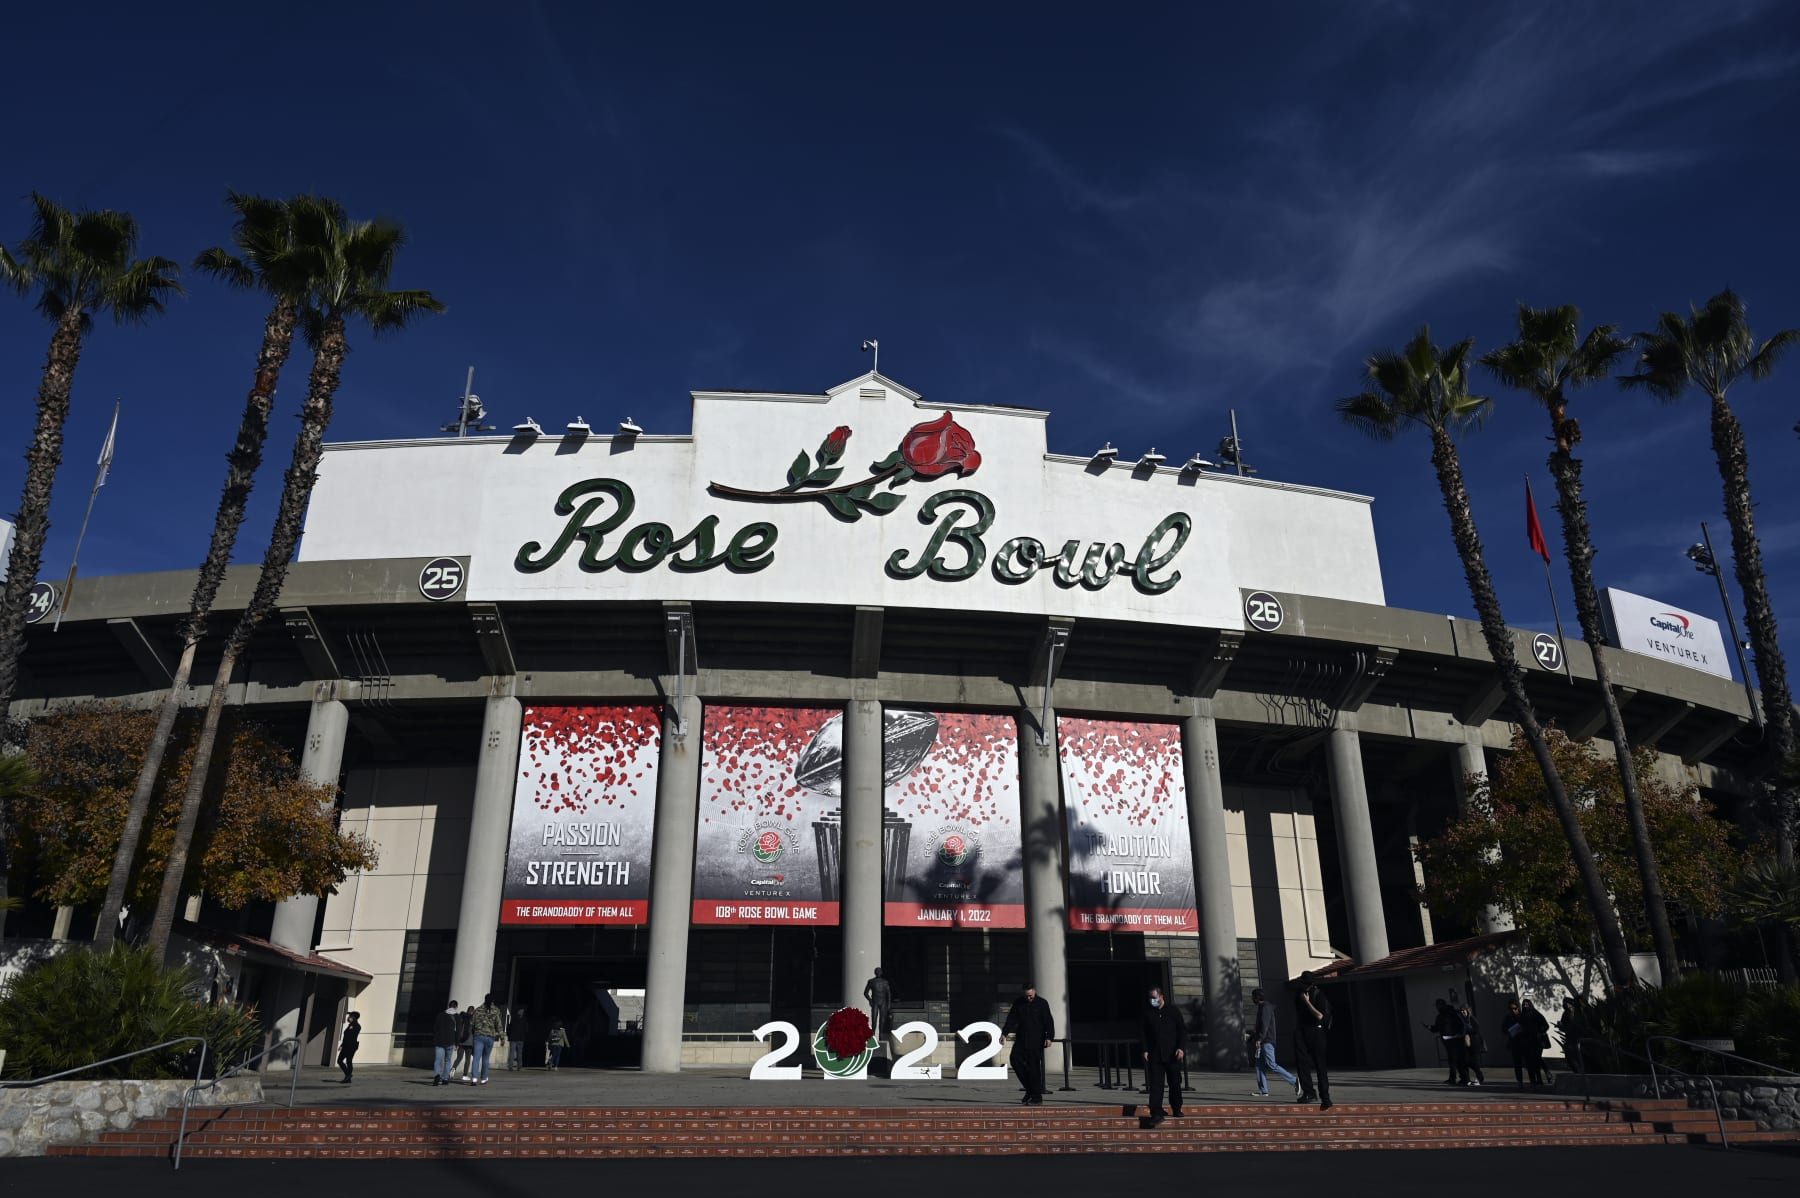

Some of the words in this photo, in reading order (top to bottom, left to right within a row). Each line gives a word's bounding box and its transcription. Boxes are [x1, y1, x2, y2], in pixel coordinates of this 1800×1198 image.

[513, 477, 779, 575] Rose
[885, 488, 1192, 597] Bowl
[423, 567, 460, 590] 25
[1250, 600, 1280, 623] 26
[1536, 641, 1557, 662] 27
[1646, 638, 1700, 663] VENTURE
[1701, 654, 1708, 665] X
[542, 822, 622, 847] PASSION
[737, 827, 755, 854] ROSE
[754, 820, 783, 832] BOWL
[784, 827, 800, 854] GAME
[1087, 833, 1172, 858] TRADITION
[525, 861, 631, 886] STRENGTH
[1100, 870, 1162, 895] HONOR
[516, 906, 531, 917] THE
[532, 906, 584, 917] GRANDDADDY
[585, 907, 596, 917] OF
[597, 907, 618, 917] THEM
[619, 907, 633, 917] ALL
[715, 906, 737, 919] 108th
[738, 906, 763, 919] ROSE
[764, 907, 791, 919] BOWL
[792, 907, 818, 920] GAME
[917, 908, 959, 921] JANUARY
[968, 909, 992, 922] 2022
[1080, 913, 1094, 924] THE
[1095, 914, 1142, 925] GRANDDADDY
[1143, 915, 1153, 925] OF
[1154, 915, 1173, 925] THEM
[1174, 915, 1187, 926] ALL
